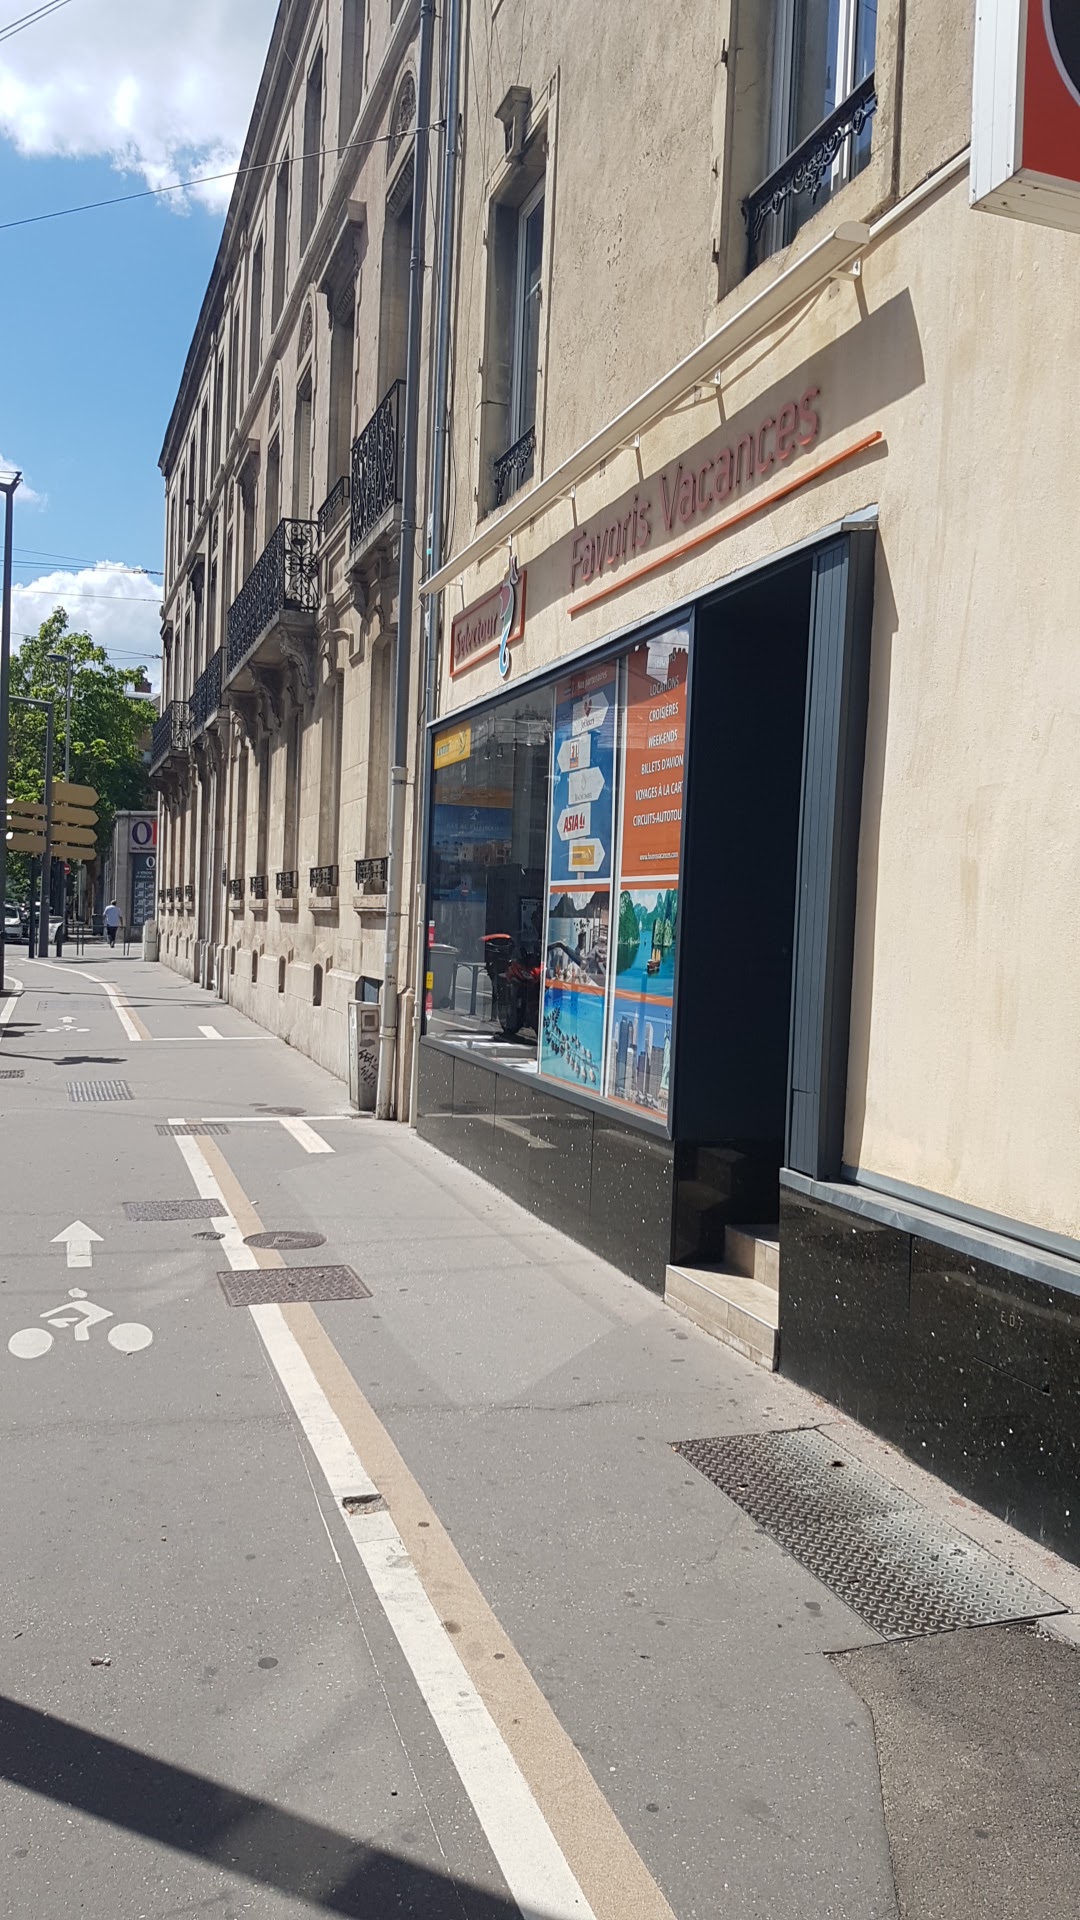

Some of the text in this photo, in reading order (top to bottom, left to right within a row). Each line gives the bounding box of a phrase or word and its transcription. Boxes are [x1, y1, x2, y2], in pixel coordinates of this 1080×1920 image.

[569, 387, 821, 590] Favoris Vacances
[455, 614, 498, 661] Selectour
[650, 676, 679, 697] LOCATIONS
[649, 701, 679, 722] CROISIÈRES
[648, 729, 678, 748] WEEK-ENDS
[641, 760, 661, 775] BILLETS
[635, 786, 658, 801] VOYAGES
[662, 783, 670, 796] LA
[563, 814, 579, 833] ASIA
